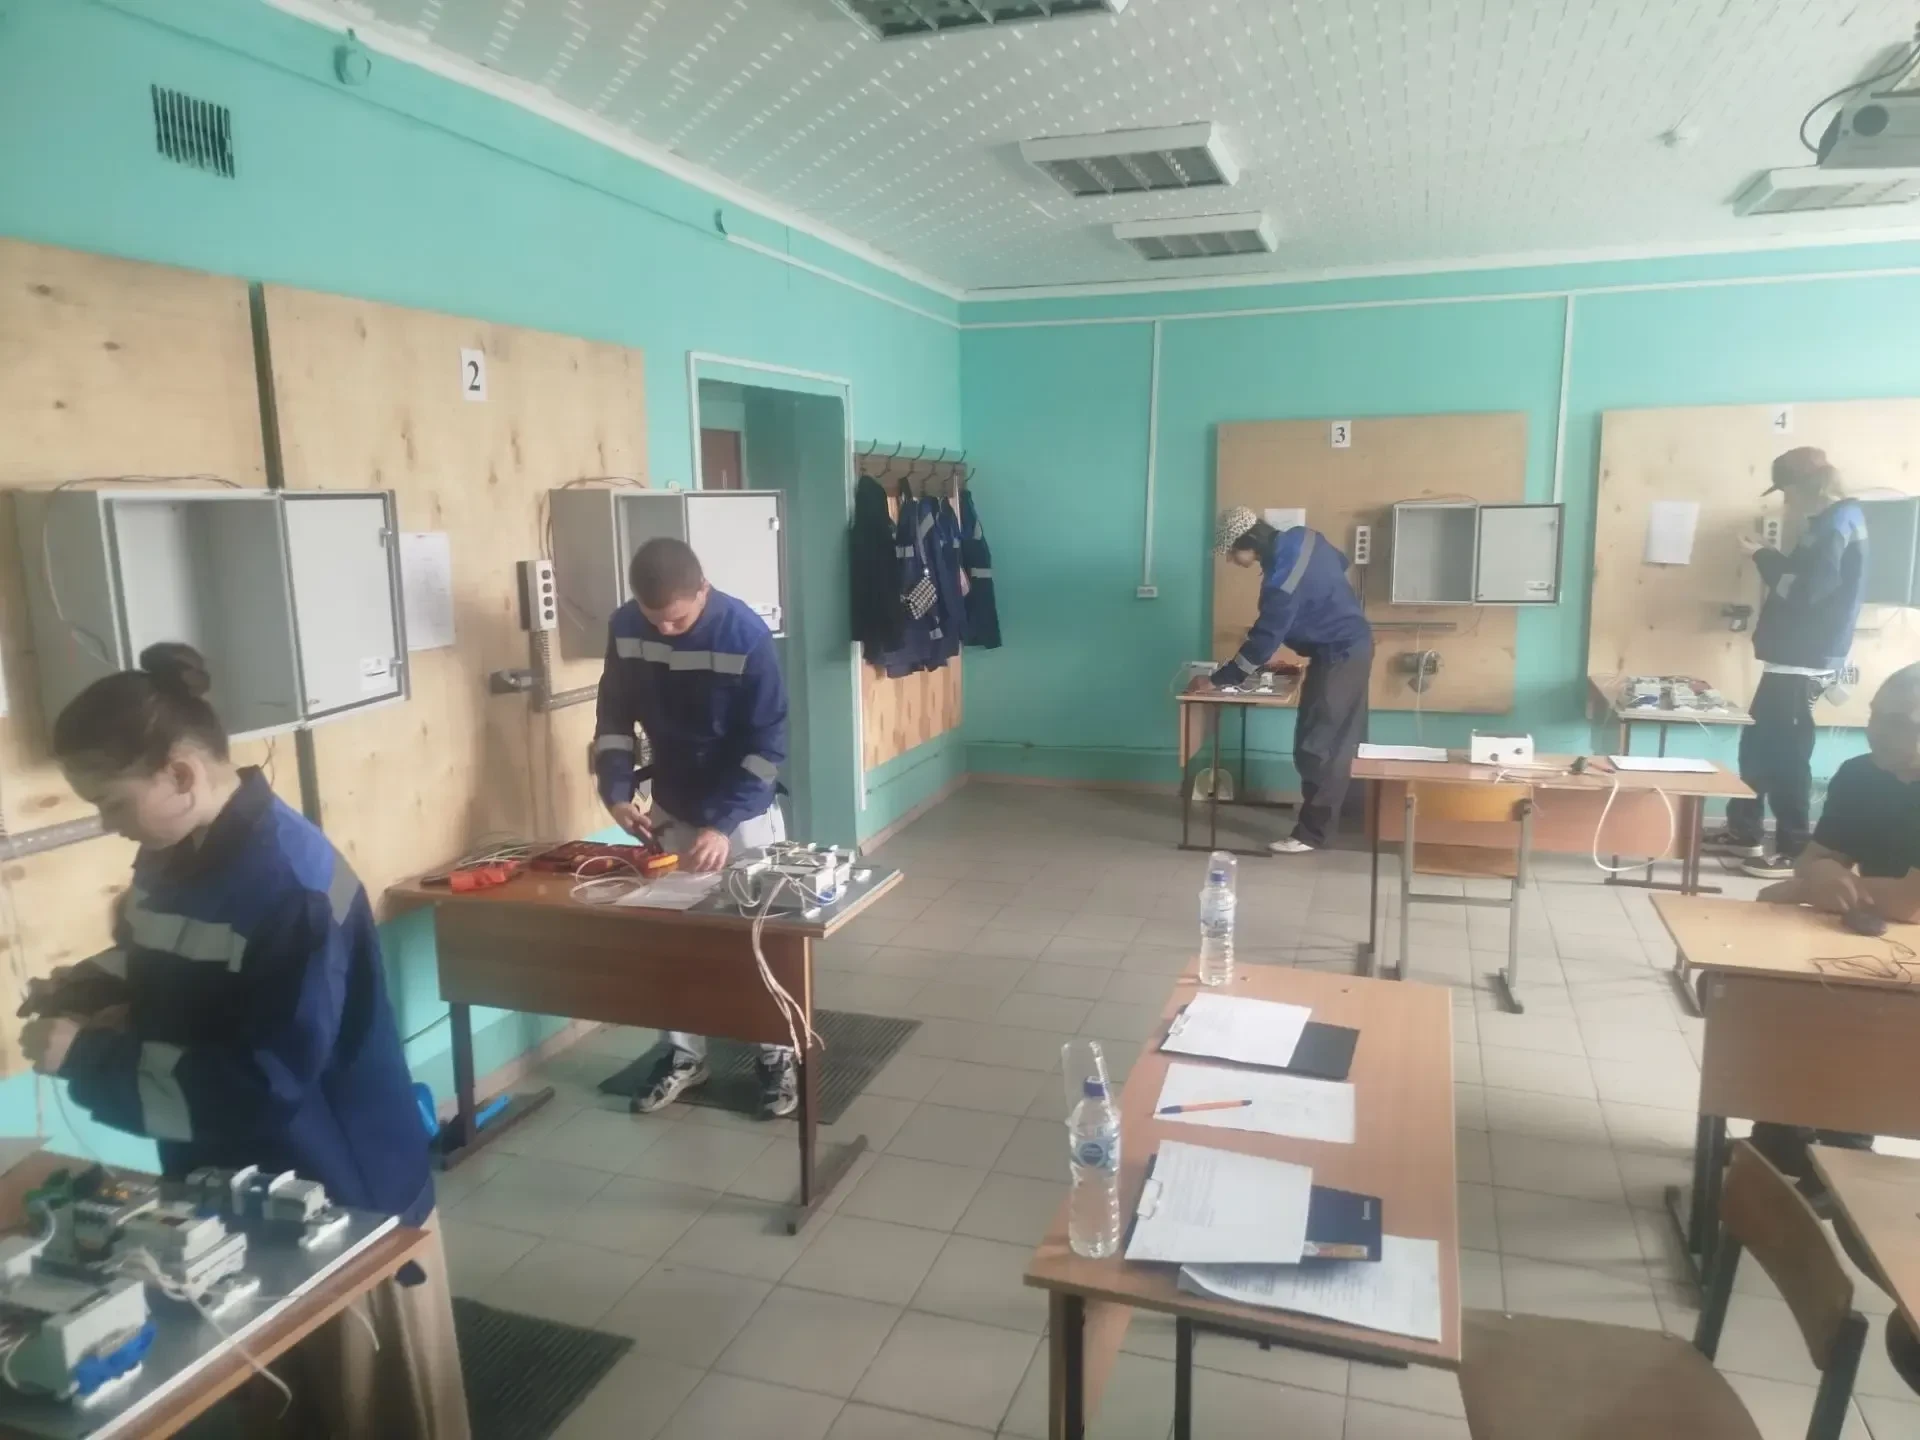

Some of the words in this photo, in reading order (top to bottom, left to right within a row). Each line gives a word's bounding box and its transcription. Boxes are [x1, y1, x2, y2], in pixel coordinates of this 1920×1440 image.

[467, 360, 481, 392] 2
[1774, 411, 1787, 430] 4
[1335, 426, 1346, 444] 3
